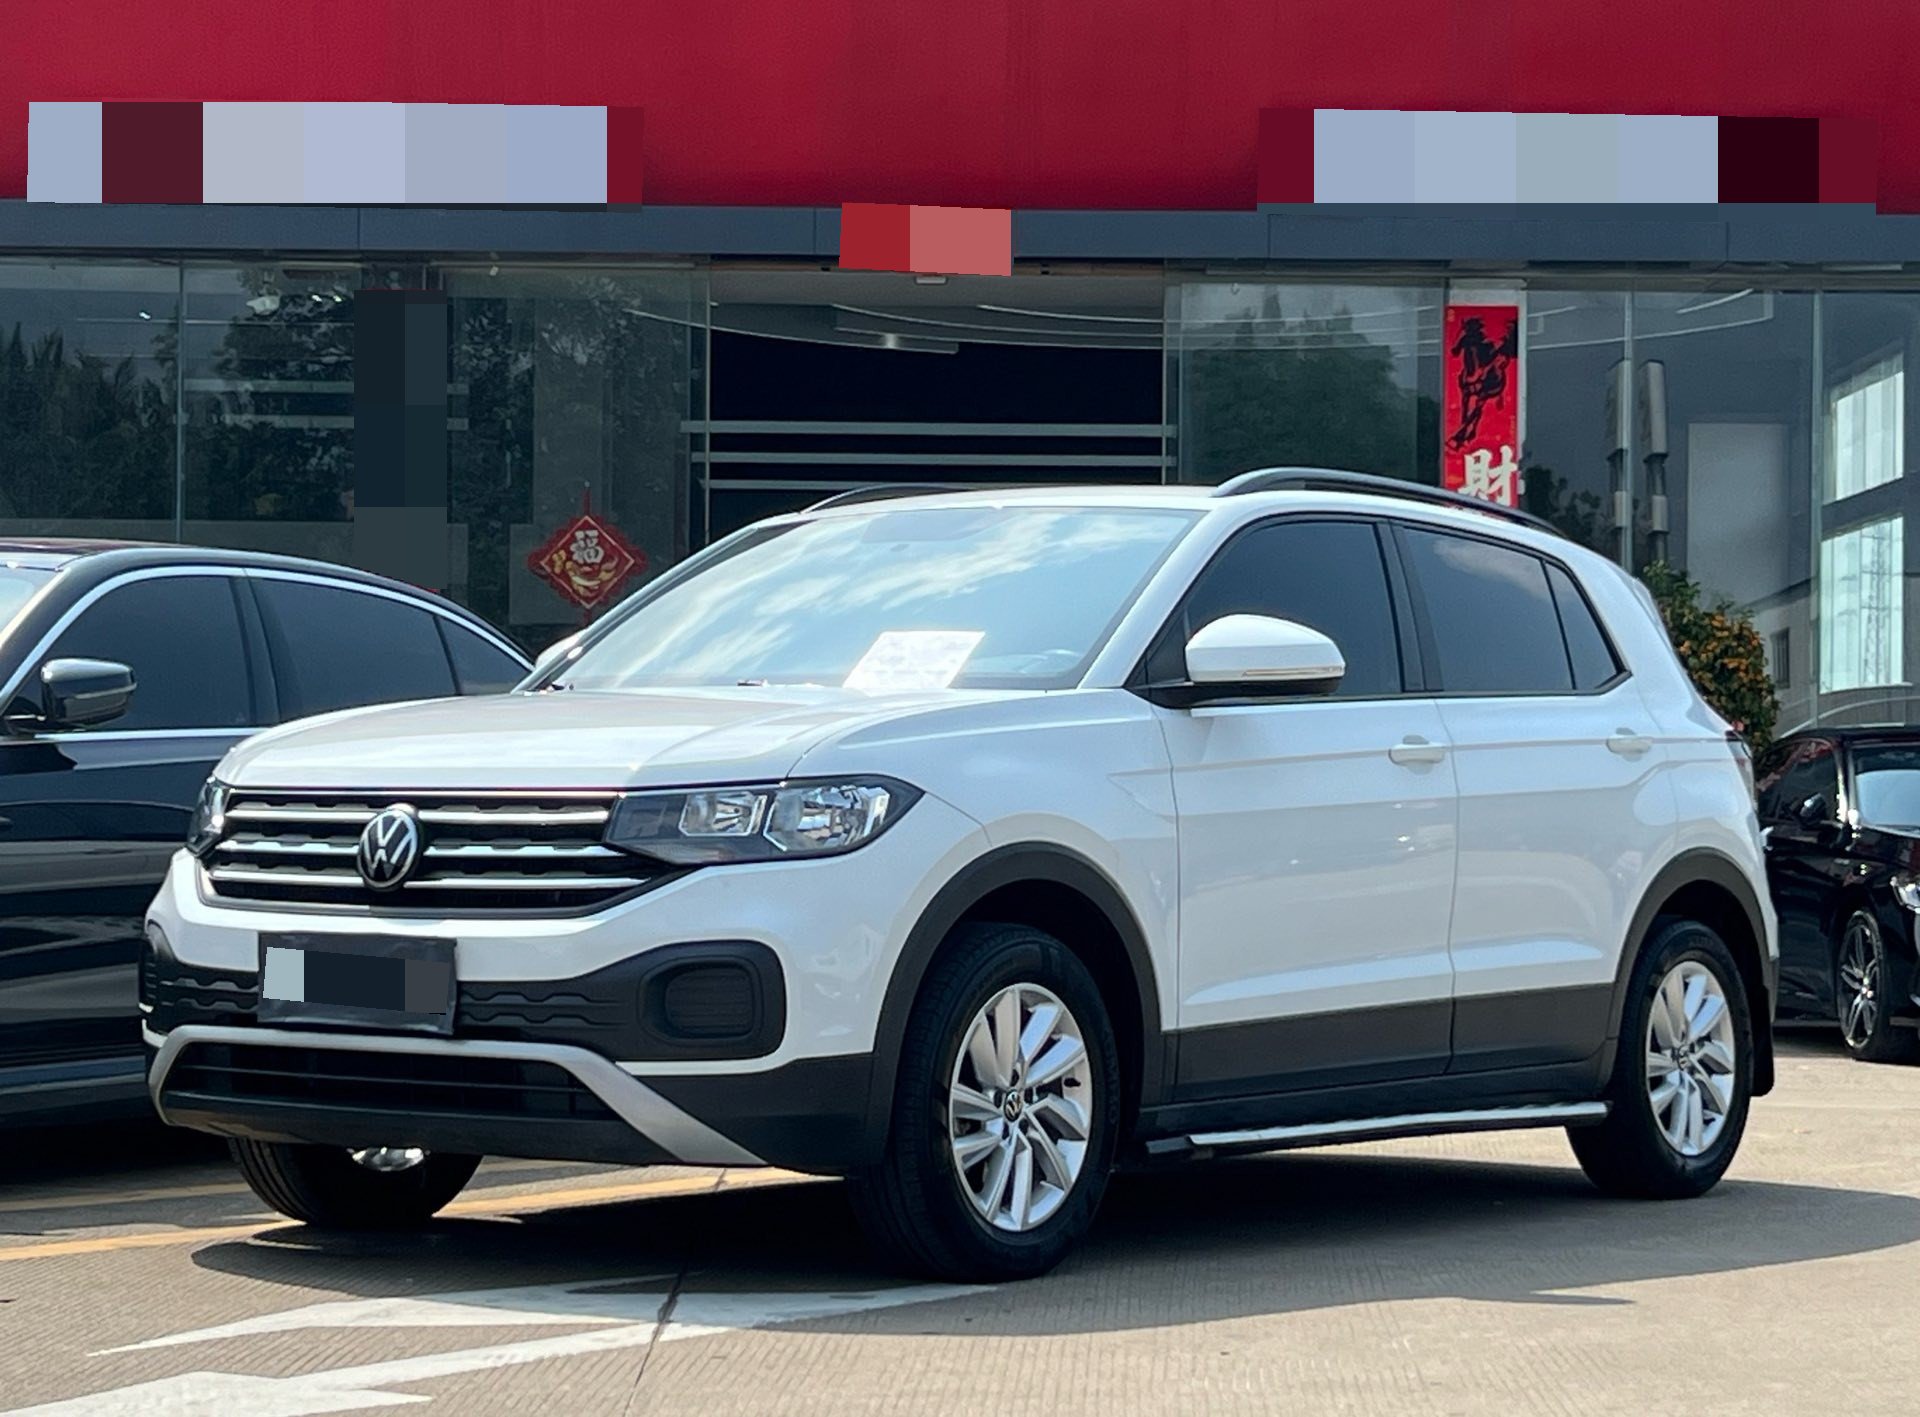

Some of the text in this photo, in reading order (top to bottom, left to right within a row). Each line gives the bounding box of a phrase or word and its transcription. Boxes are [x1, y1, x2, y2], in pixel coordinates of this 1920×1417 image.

[1457, 445, 1518, 506] 財
[570, 529, 604, 564] 福
[360, 810, 417, 882] VW
